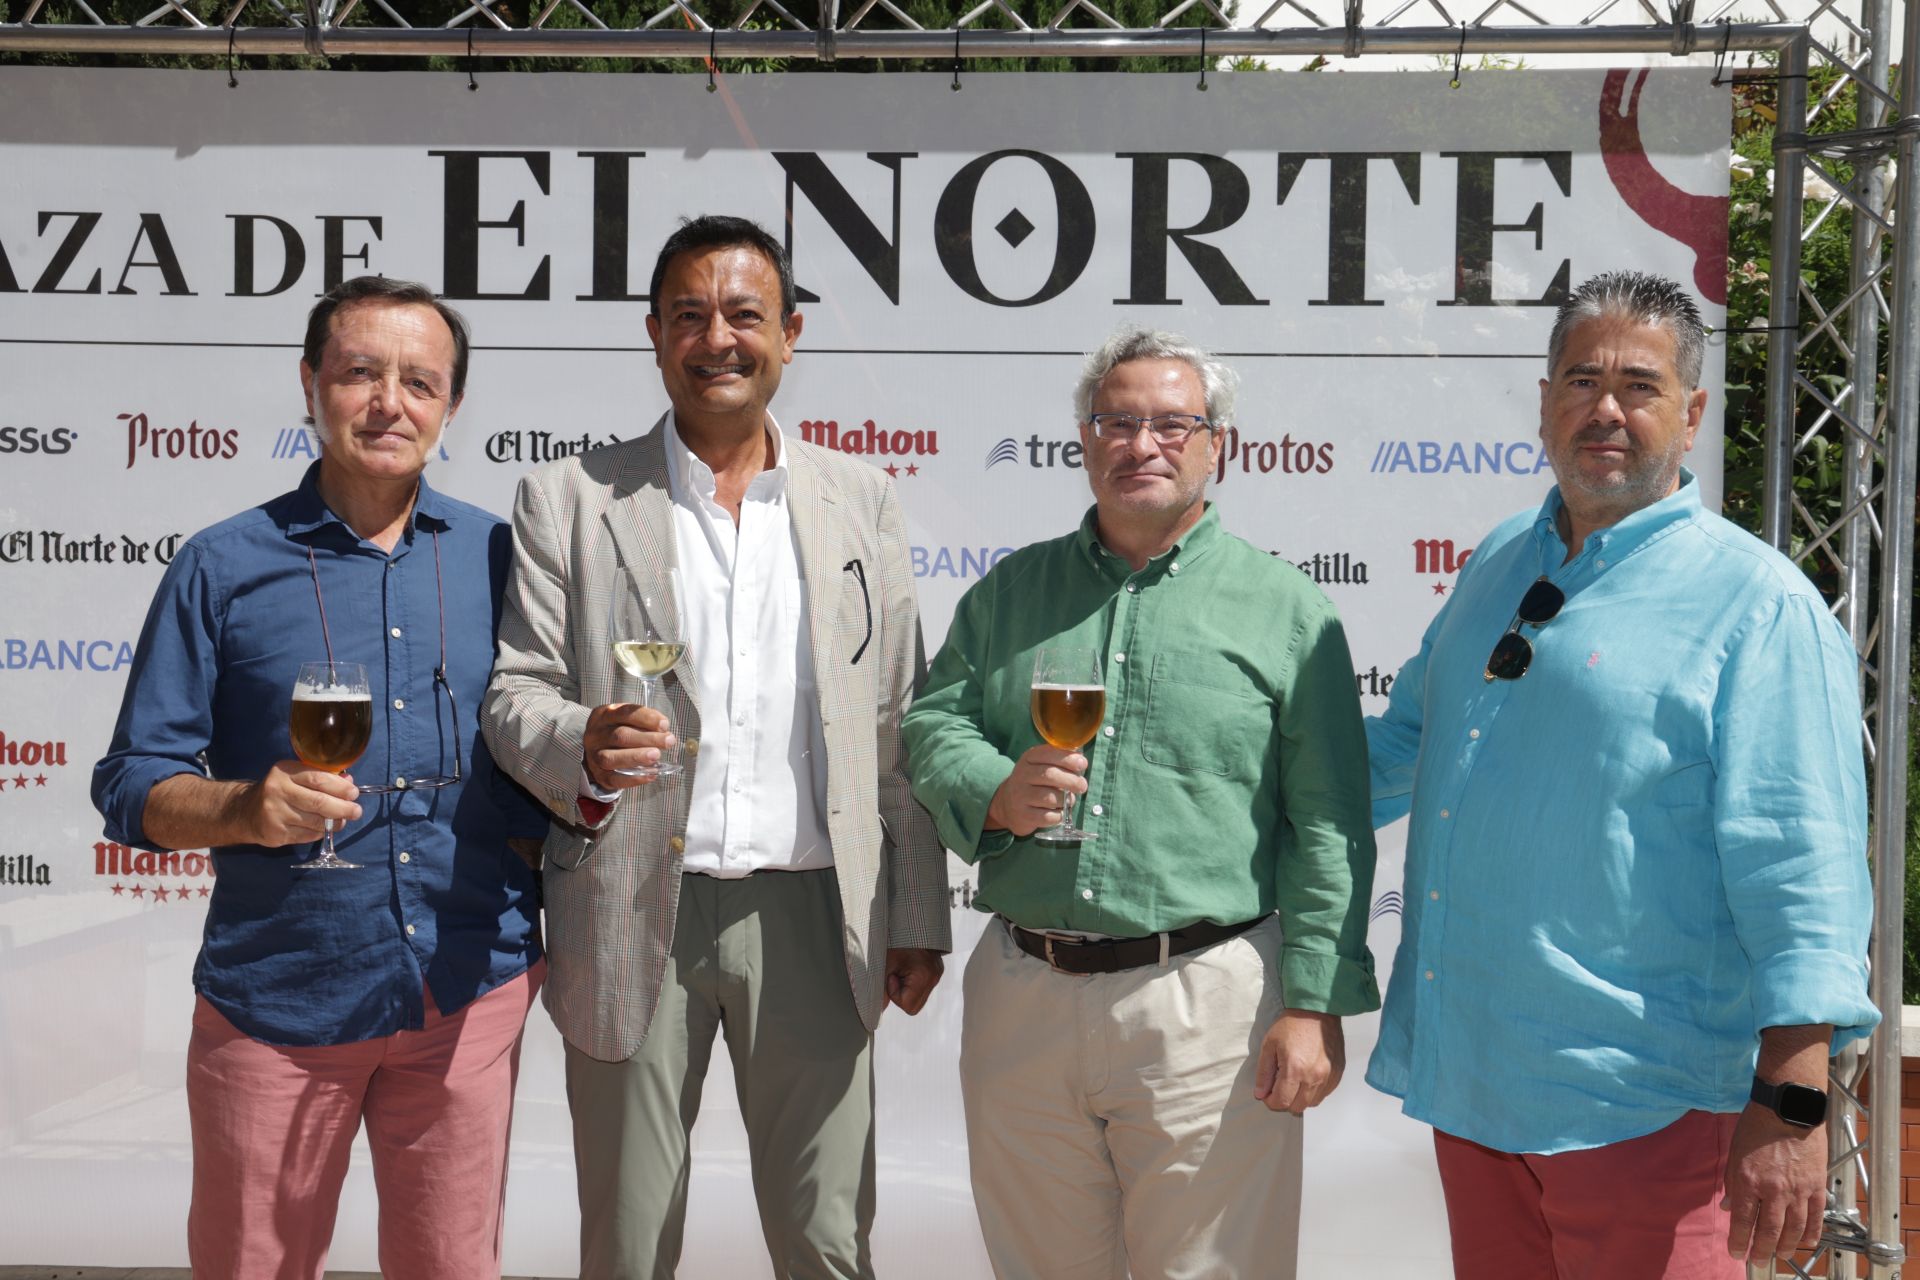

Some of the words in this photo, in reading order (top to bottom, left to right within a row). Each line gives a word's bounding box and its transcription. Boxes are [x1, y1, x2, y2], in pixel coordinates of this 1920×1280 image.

[225, 214, 382, 298] DE
[771, 149, 1571, 307] NORTE
[117, 412, 239, 469] Protos
[485, 430, 522, 463] El
[799, 419, 939, 455] Mahou
[1216, 426, 1334, 484] Protos
[0, 531, 34, 563] El
[39, 531, 117, 564] Norte
[121, 534, 150, 564] de
[1297, 552, 1370, 585] stilla
[0, 639, 134, 671] BANCA
[0, 730, 67, 766] hou
